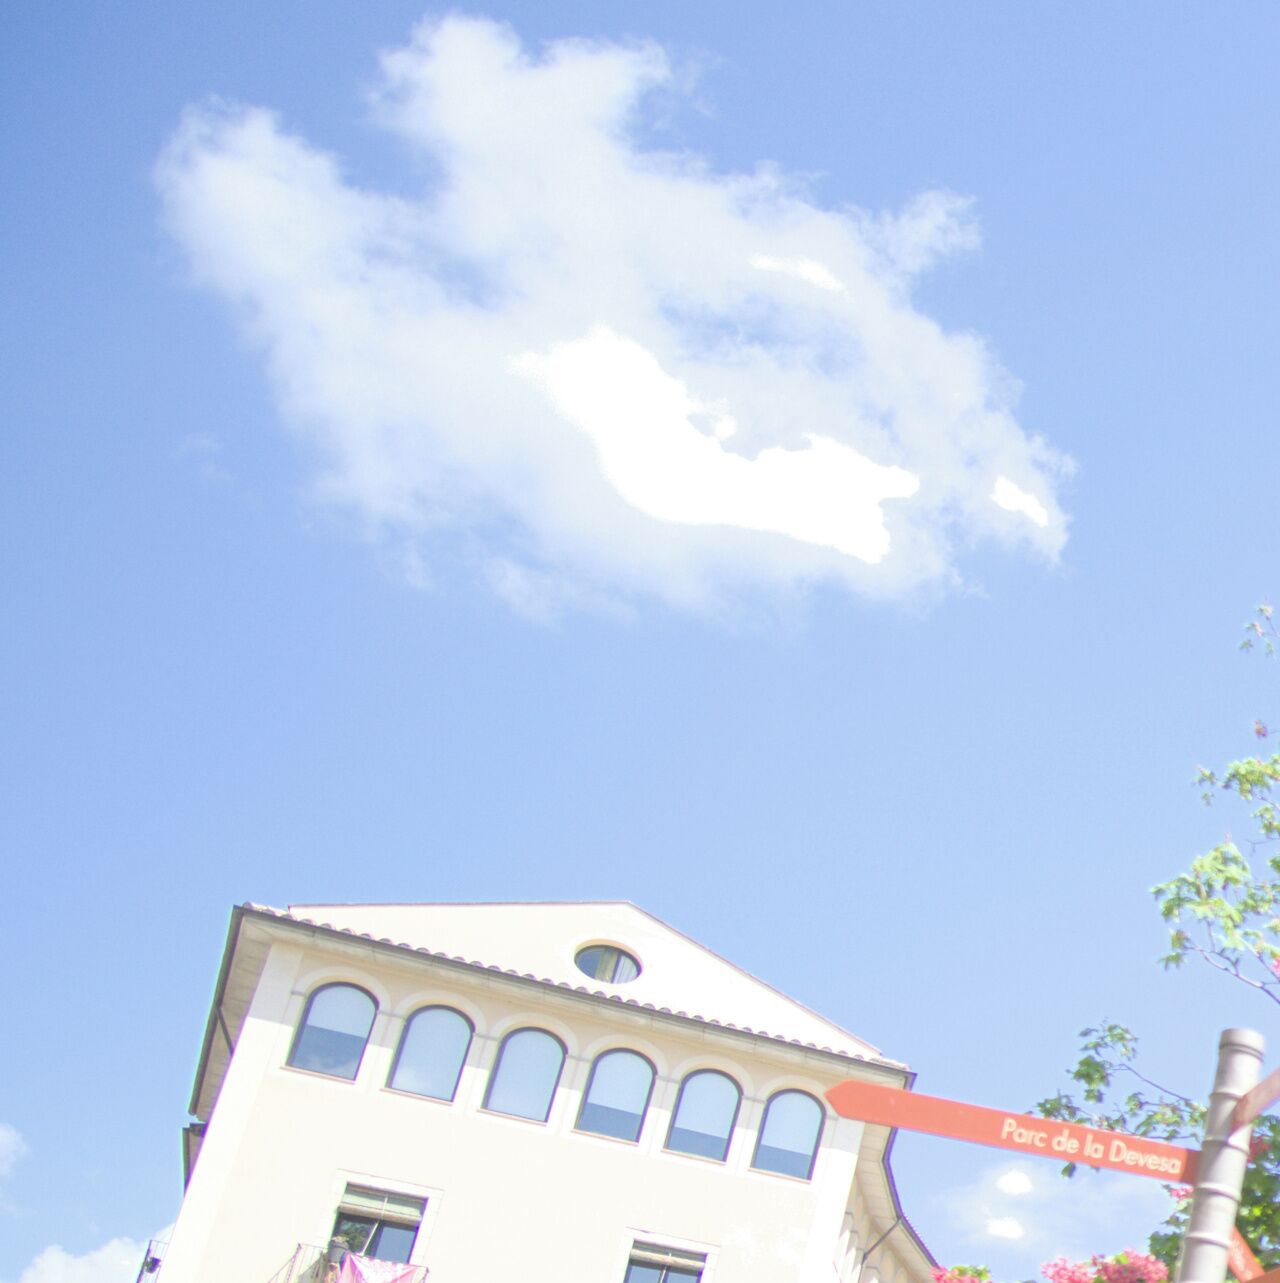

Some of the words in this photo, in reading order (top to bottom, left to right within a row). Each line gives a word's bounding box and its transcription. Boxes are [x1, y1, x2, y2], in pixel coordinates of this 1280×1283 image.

[1000, 1118, 1048, 1147] Parc
[1051, 1128, 1080, 1154] de
[1083, 1133, 1105, 1159] la
[1108, 1140, 1182, 1174] Devesa
